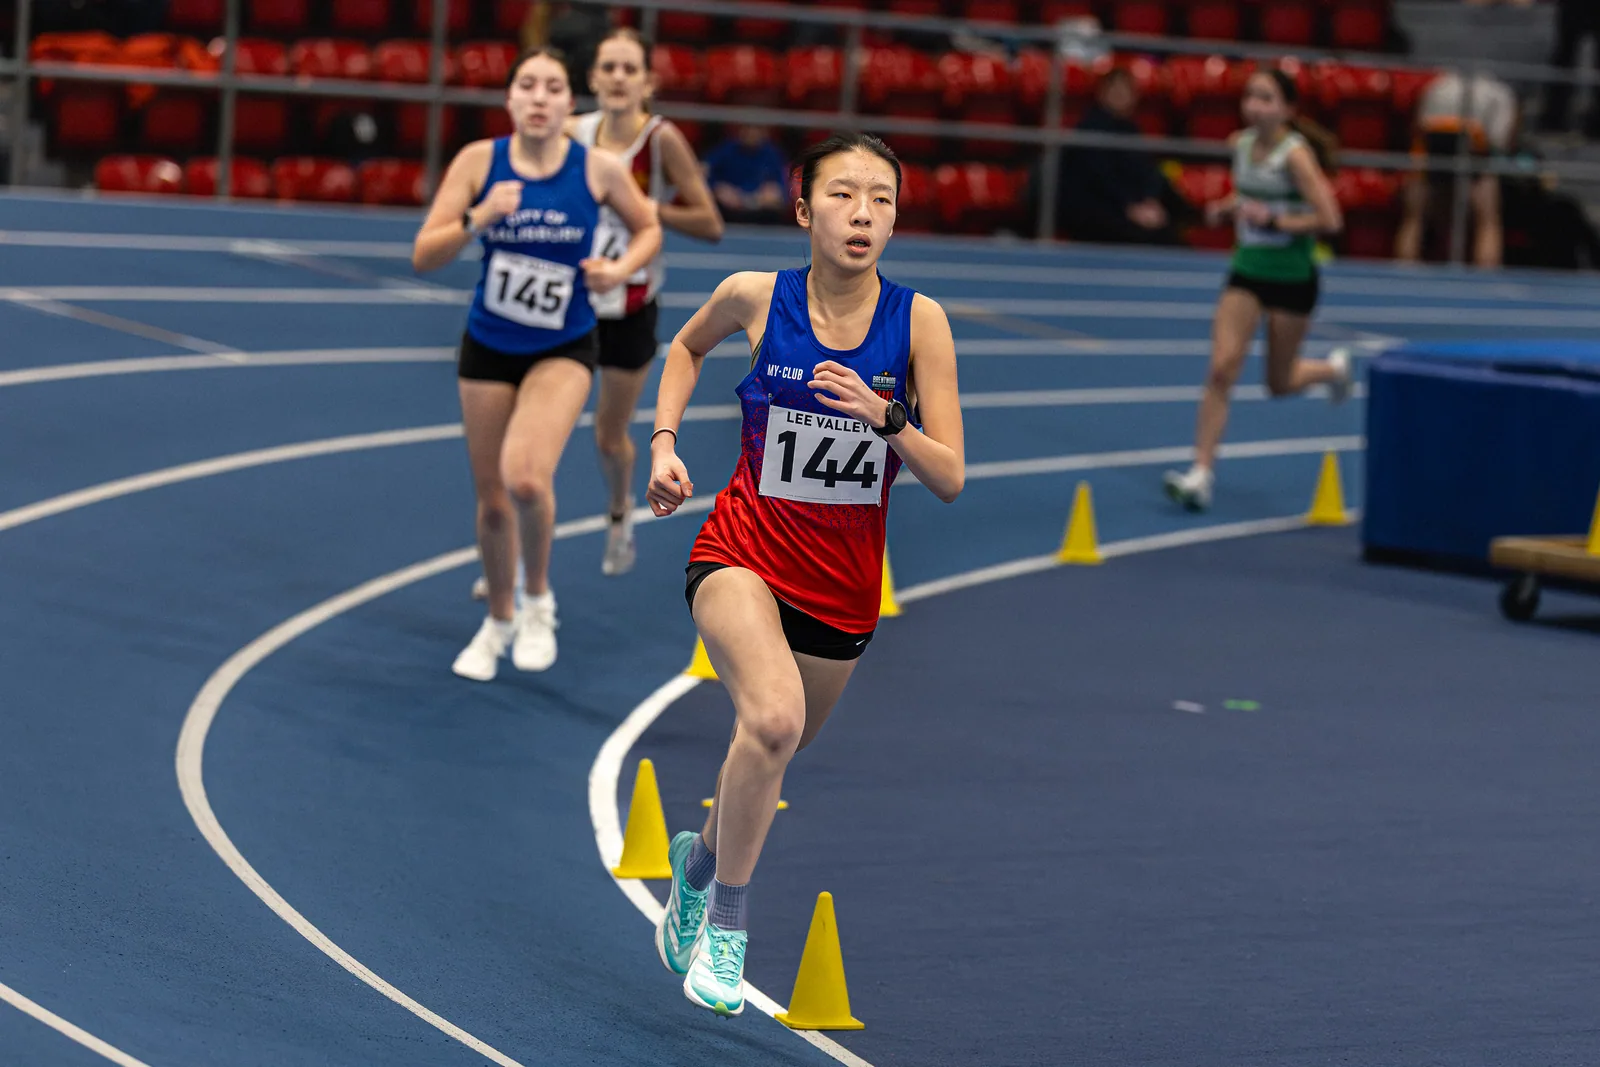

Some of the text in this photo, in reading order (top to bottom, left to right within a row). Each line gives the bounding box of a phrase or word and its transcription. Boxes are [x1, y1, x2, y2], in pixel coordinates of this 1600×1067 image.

[497, 270, 563, 314] 145
[786, 411, 870, 433] LEE VALLEY
[777, 430, 879, 489] 144
